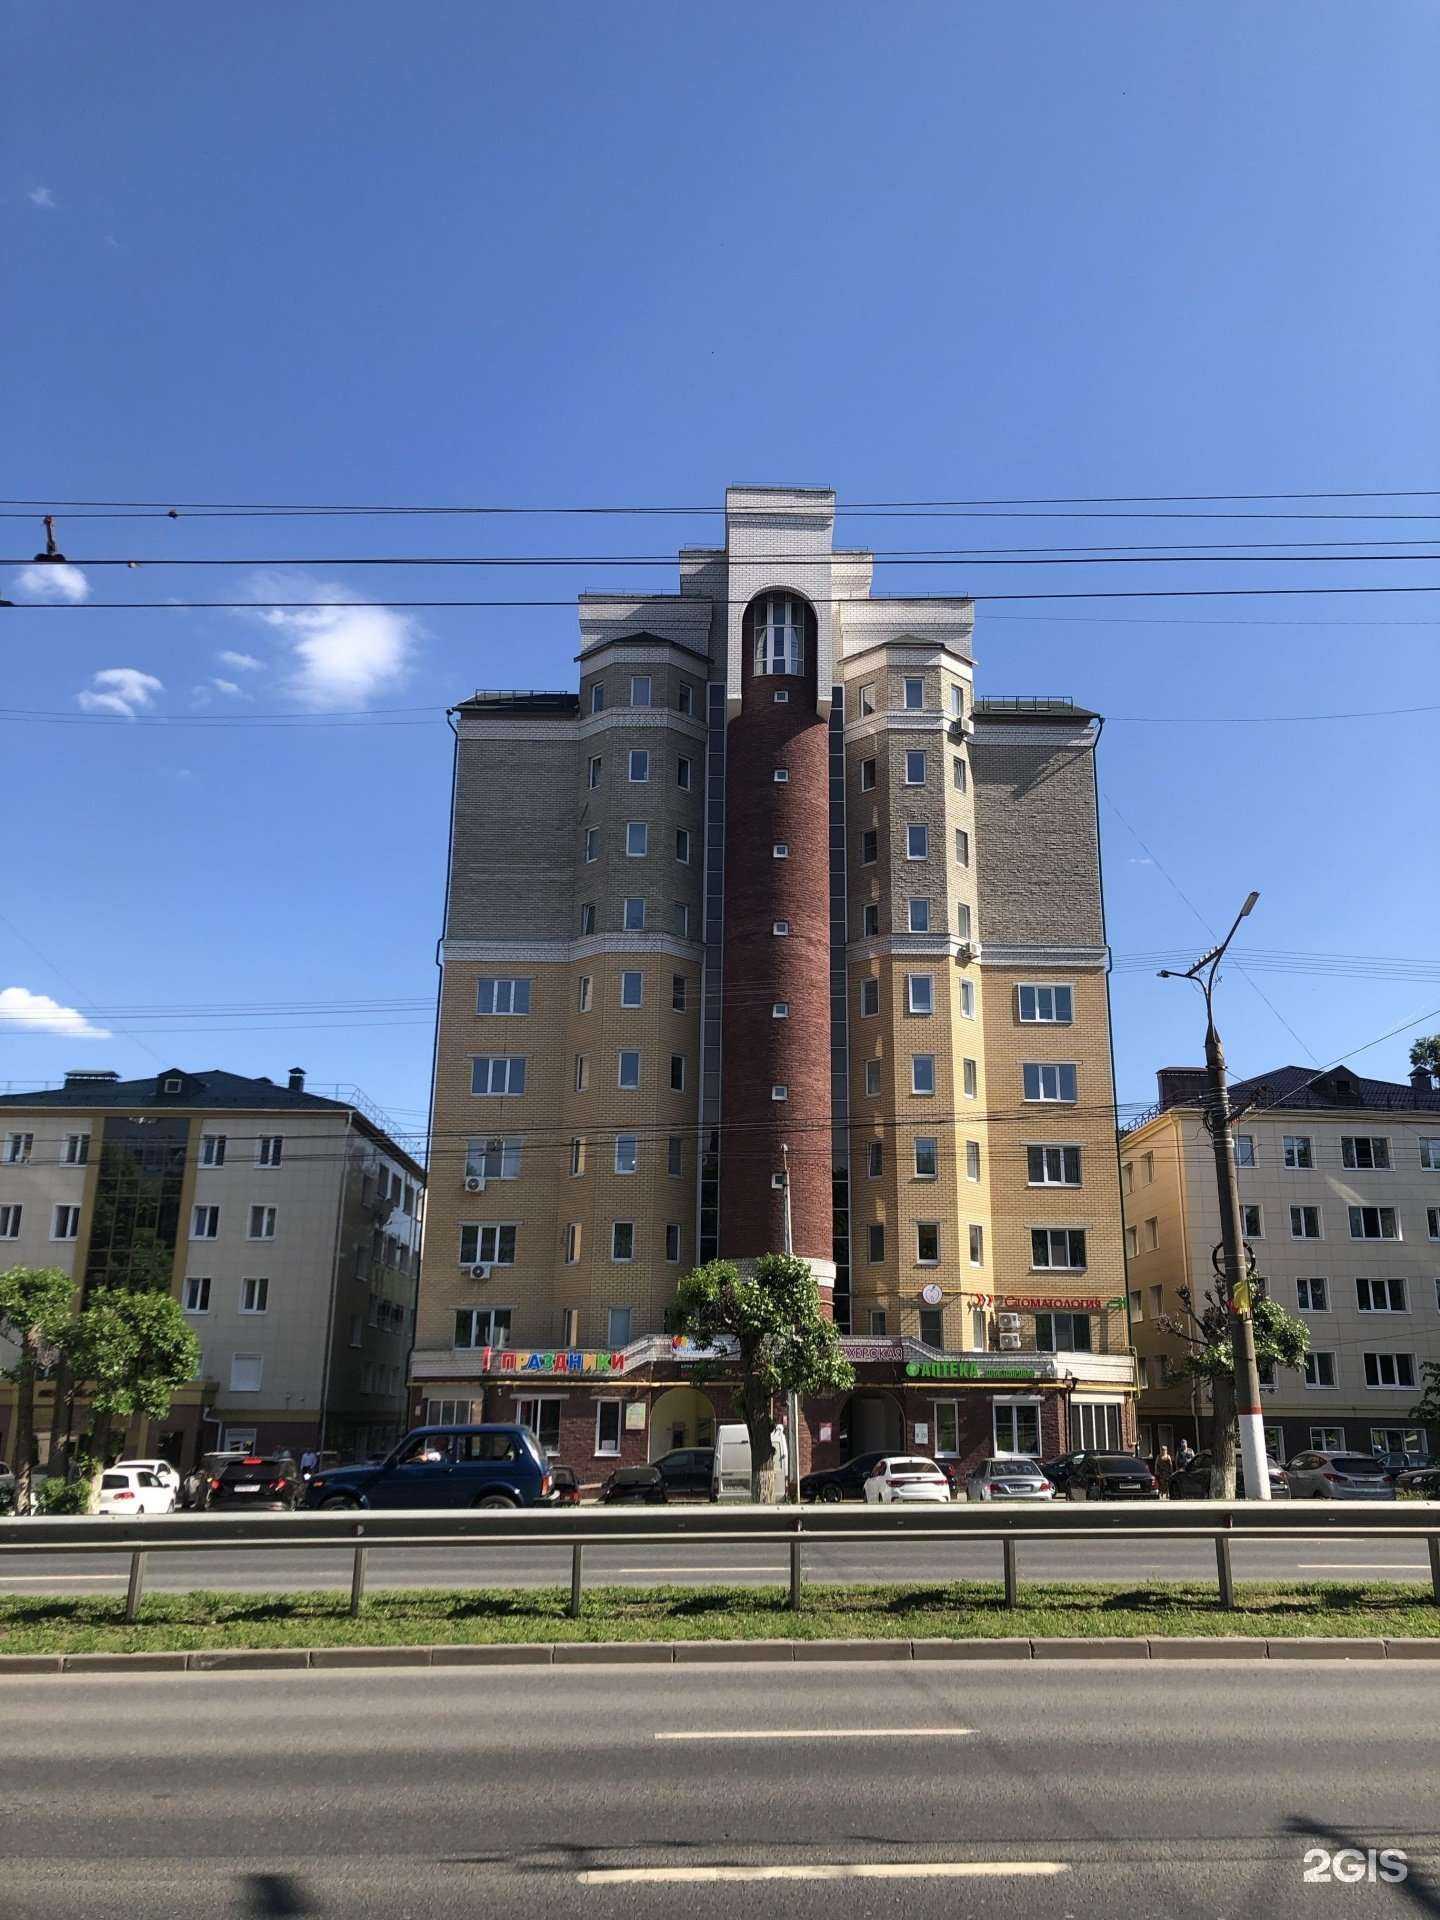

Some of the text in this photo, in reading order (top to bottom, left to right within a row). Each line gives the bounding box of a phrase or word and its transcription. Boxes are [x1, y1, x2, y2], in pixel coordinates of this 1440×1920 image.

[840, 1346, 903, 1360] ХЕРСКАЯ
[501, 1351, 625, 1374] ПРАЗДНИКИ
[921, 1361, 979, 1377] АПТЕКА
